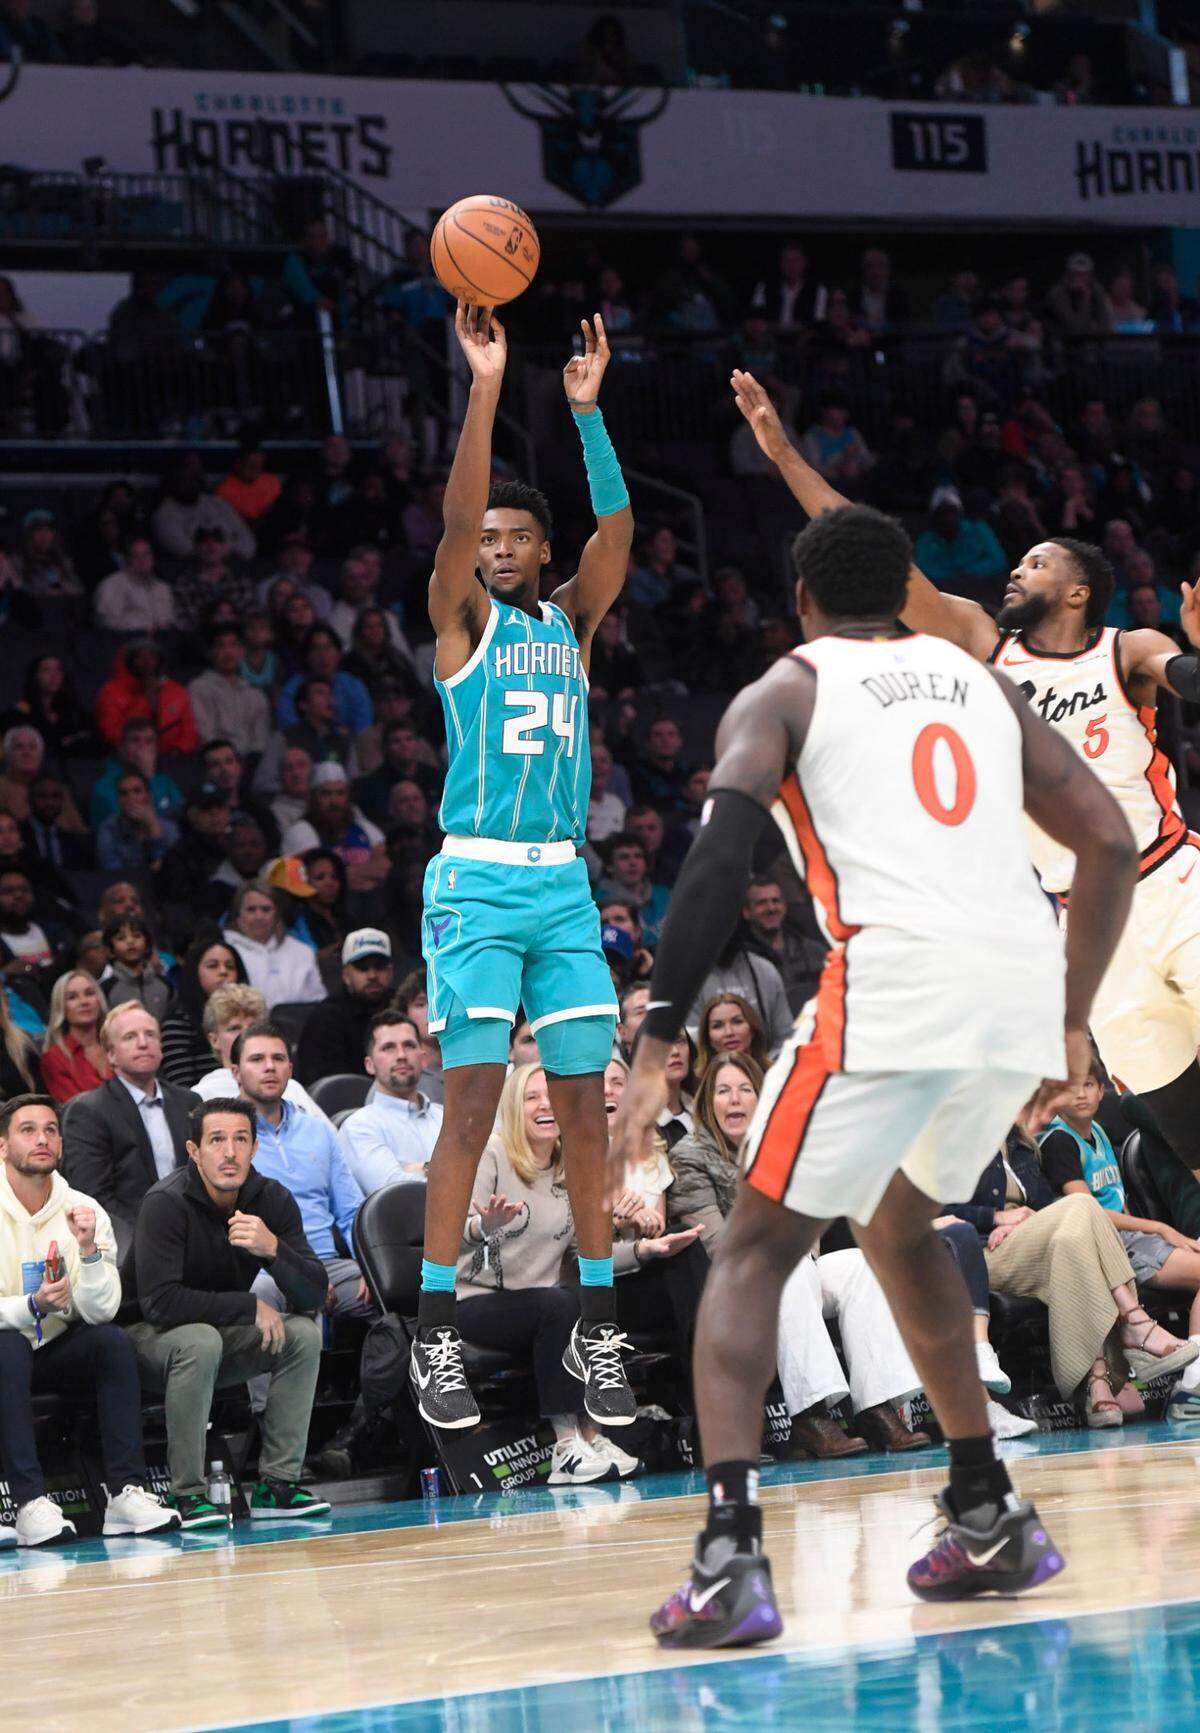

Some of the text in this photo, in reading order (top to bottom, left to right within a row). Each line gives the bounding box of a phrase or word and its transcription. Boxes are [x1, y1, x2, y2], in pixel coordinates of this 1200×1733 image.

[151, 107, 394, 178] HORNETS
[908, 121, 970, 164] 115
[1074, 139, 1200, 199] HORN
[491, 641, 581, 680] HORNET
[861, 671, 969, 708] DUREN
[501, 689, 579, 759] 24
[1082, 713, 1110, 759] 5
[911, 722, 978, 828] 0
[483, 1435, 538, 1467] UTILITY
[509, 1443, 557, 1473] INNOVAT
[469, 1472, 483, 1489] 1
[500, 1467, 536, 1490] GROUP
